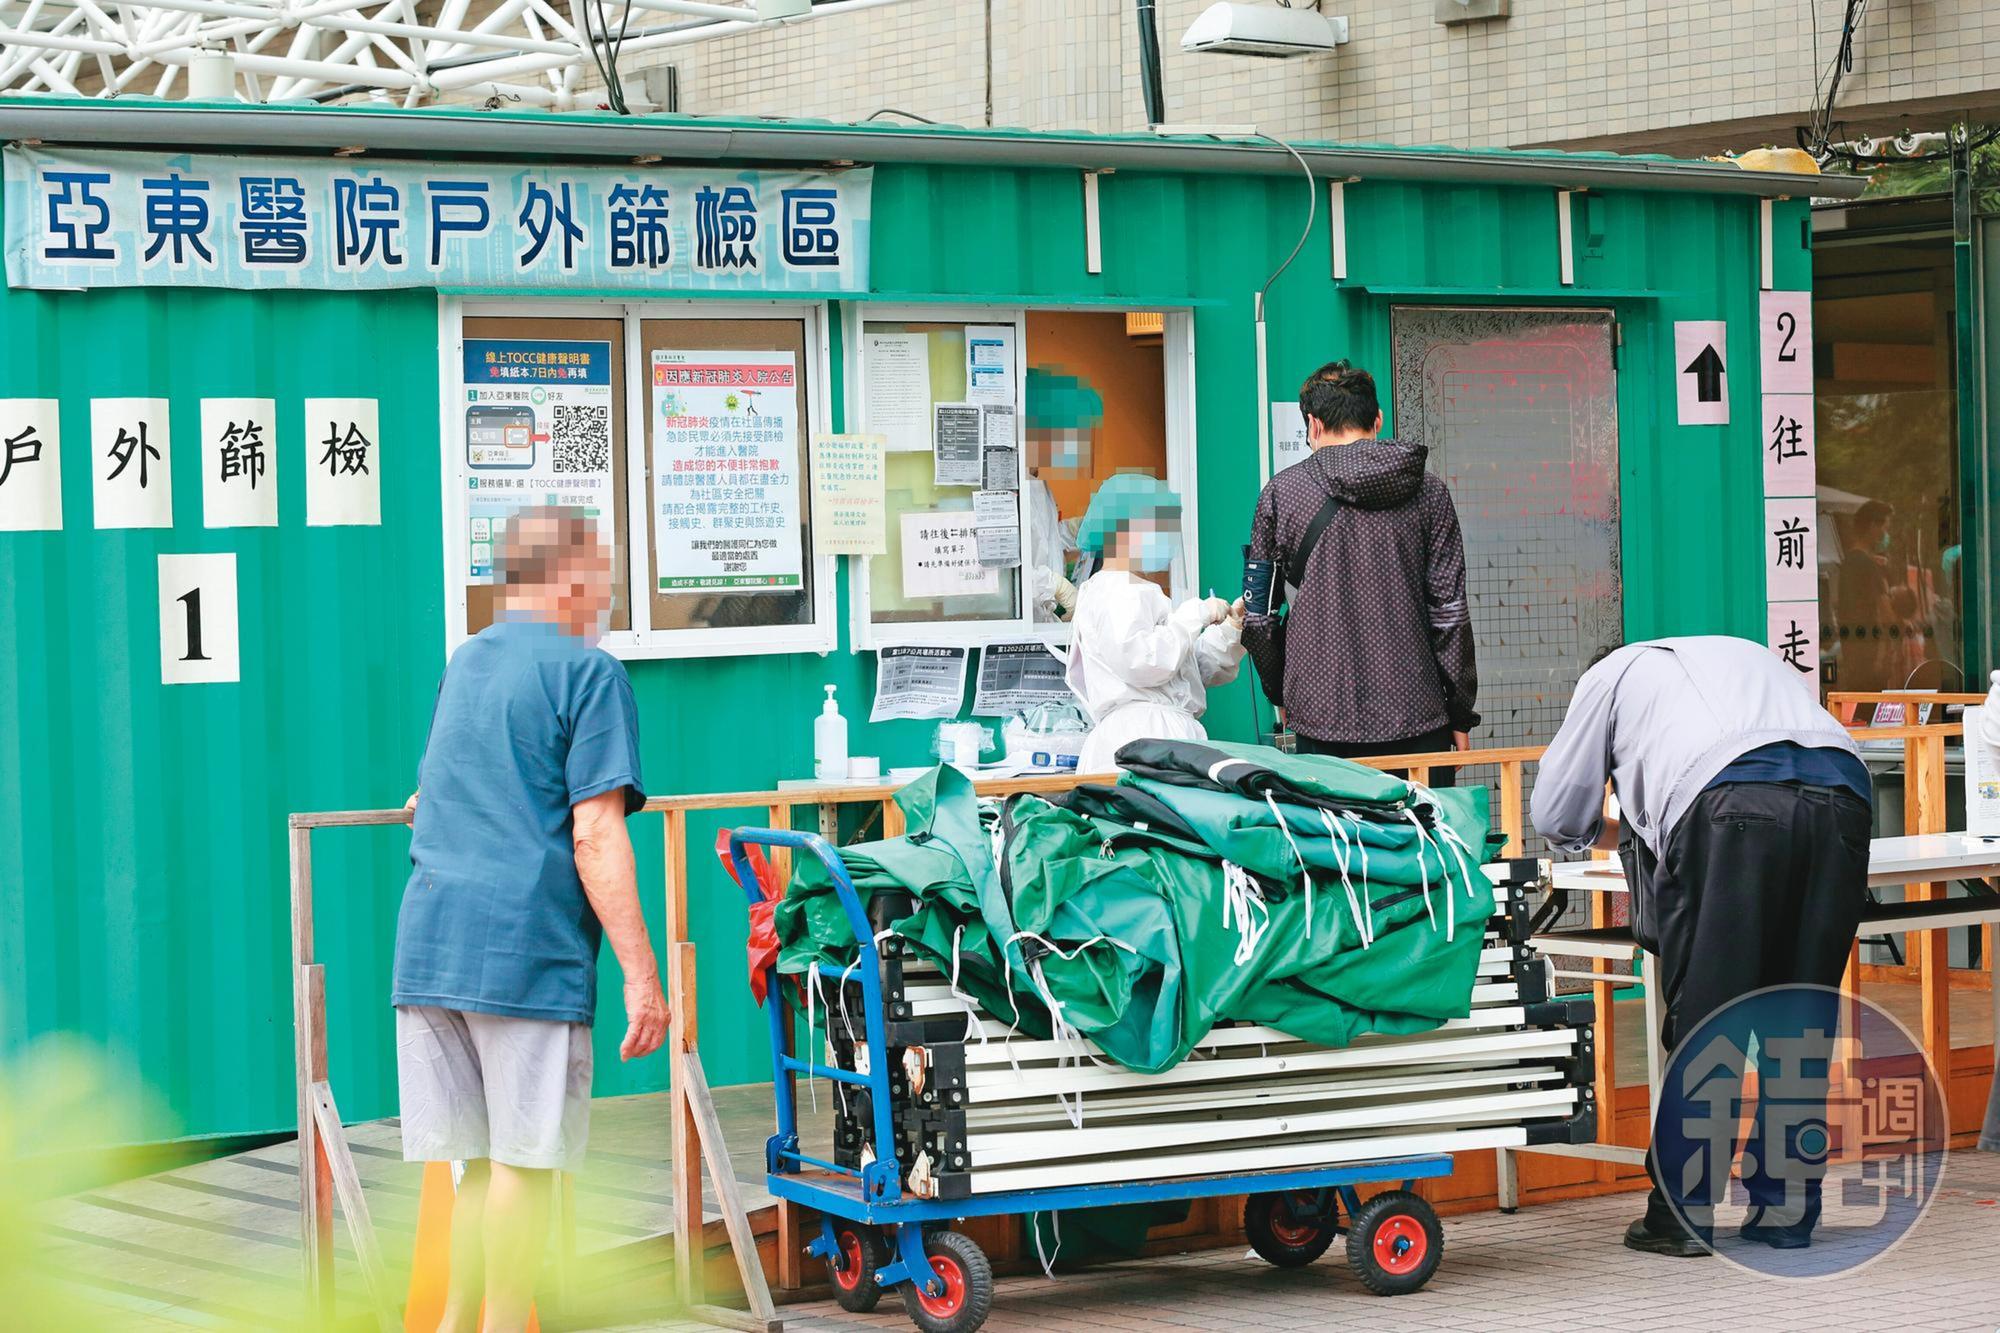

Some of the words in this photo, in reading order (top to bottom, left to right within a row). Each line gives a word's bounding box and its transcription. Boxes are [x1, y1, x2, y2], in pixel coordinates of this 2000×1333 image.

[42, 171, 840, 270] 亞東醫院戶外篩檢區
[485, 352, 590, 365] 線上TOCC健康聲明書
[666, 368, 793, 384] 因應新冠肺炎入院公告
[0, 419, 371, 490] 戶外篩檢
[694, 445, 759, 457] 才能進入醫院
[672, 459, 780, 472] 造成您的不便非常抱歉
[690, 487, 765, 500] 為社區安全把關
[723, 562, 747, 572] 謝謝您
[176, 587, 212, 661] 1
